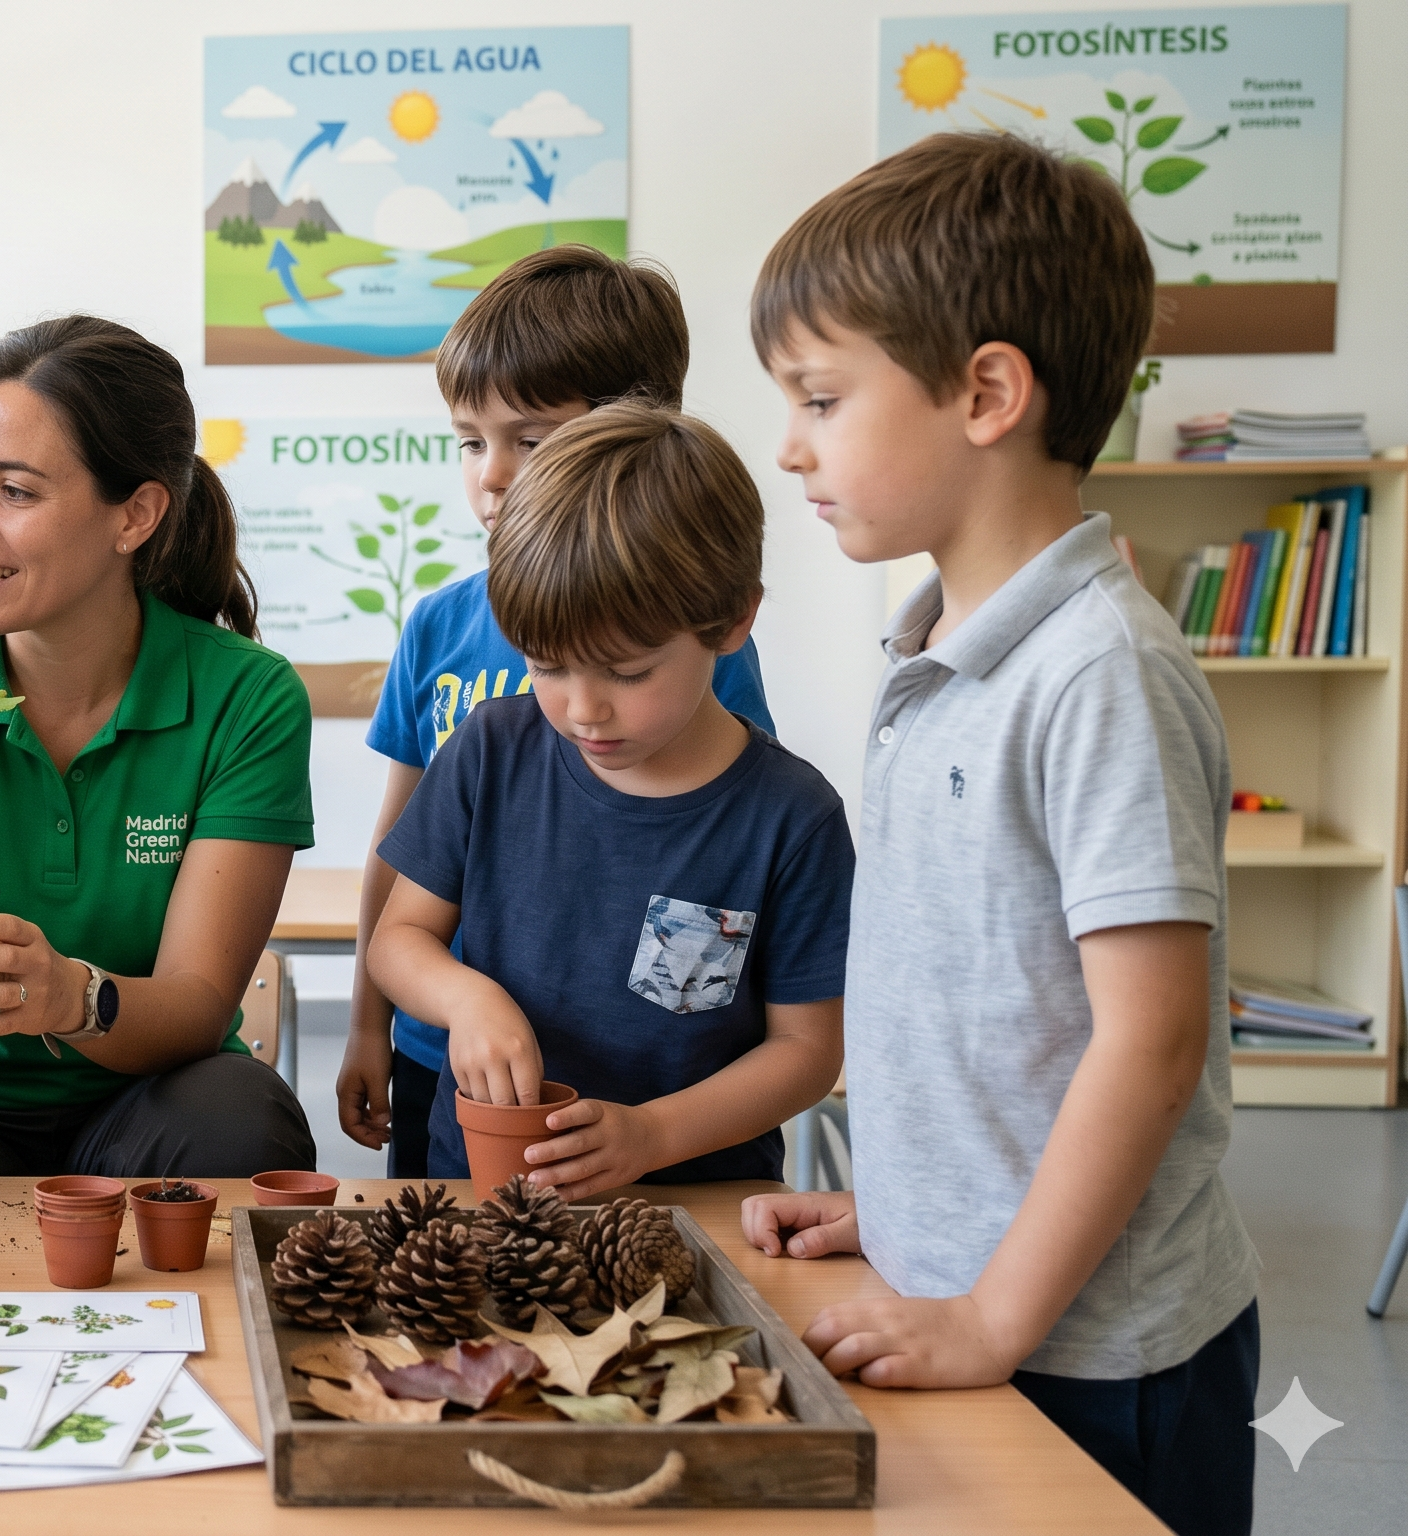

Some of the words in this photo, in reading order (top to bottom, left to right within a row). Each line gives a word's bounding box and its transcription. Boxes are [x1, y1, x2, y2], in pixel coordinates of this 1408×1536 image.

[993, 22, 1228, 58] FOTOSÍNTESIS
[288, 48, 377, 76] CICLO
[387, 48, 444, 74] DEL
[453, 45, 541, 72] AGUA
[271, 428, 462, 464] FOTOSÍNT
[126, 813, 188, 831] Madrid
[126, 832, 180, 847] Green
[126, 849, 184, 864] Nature
